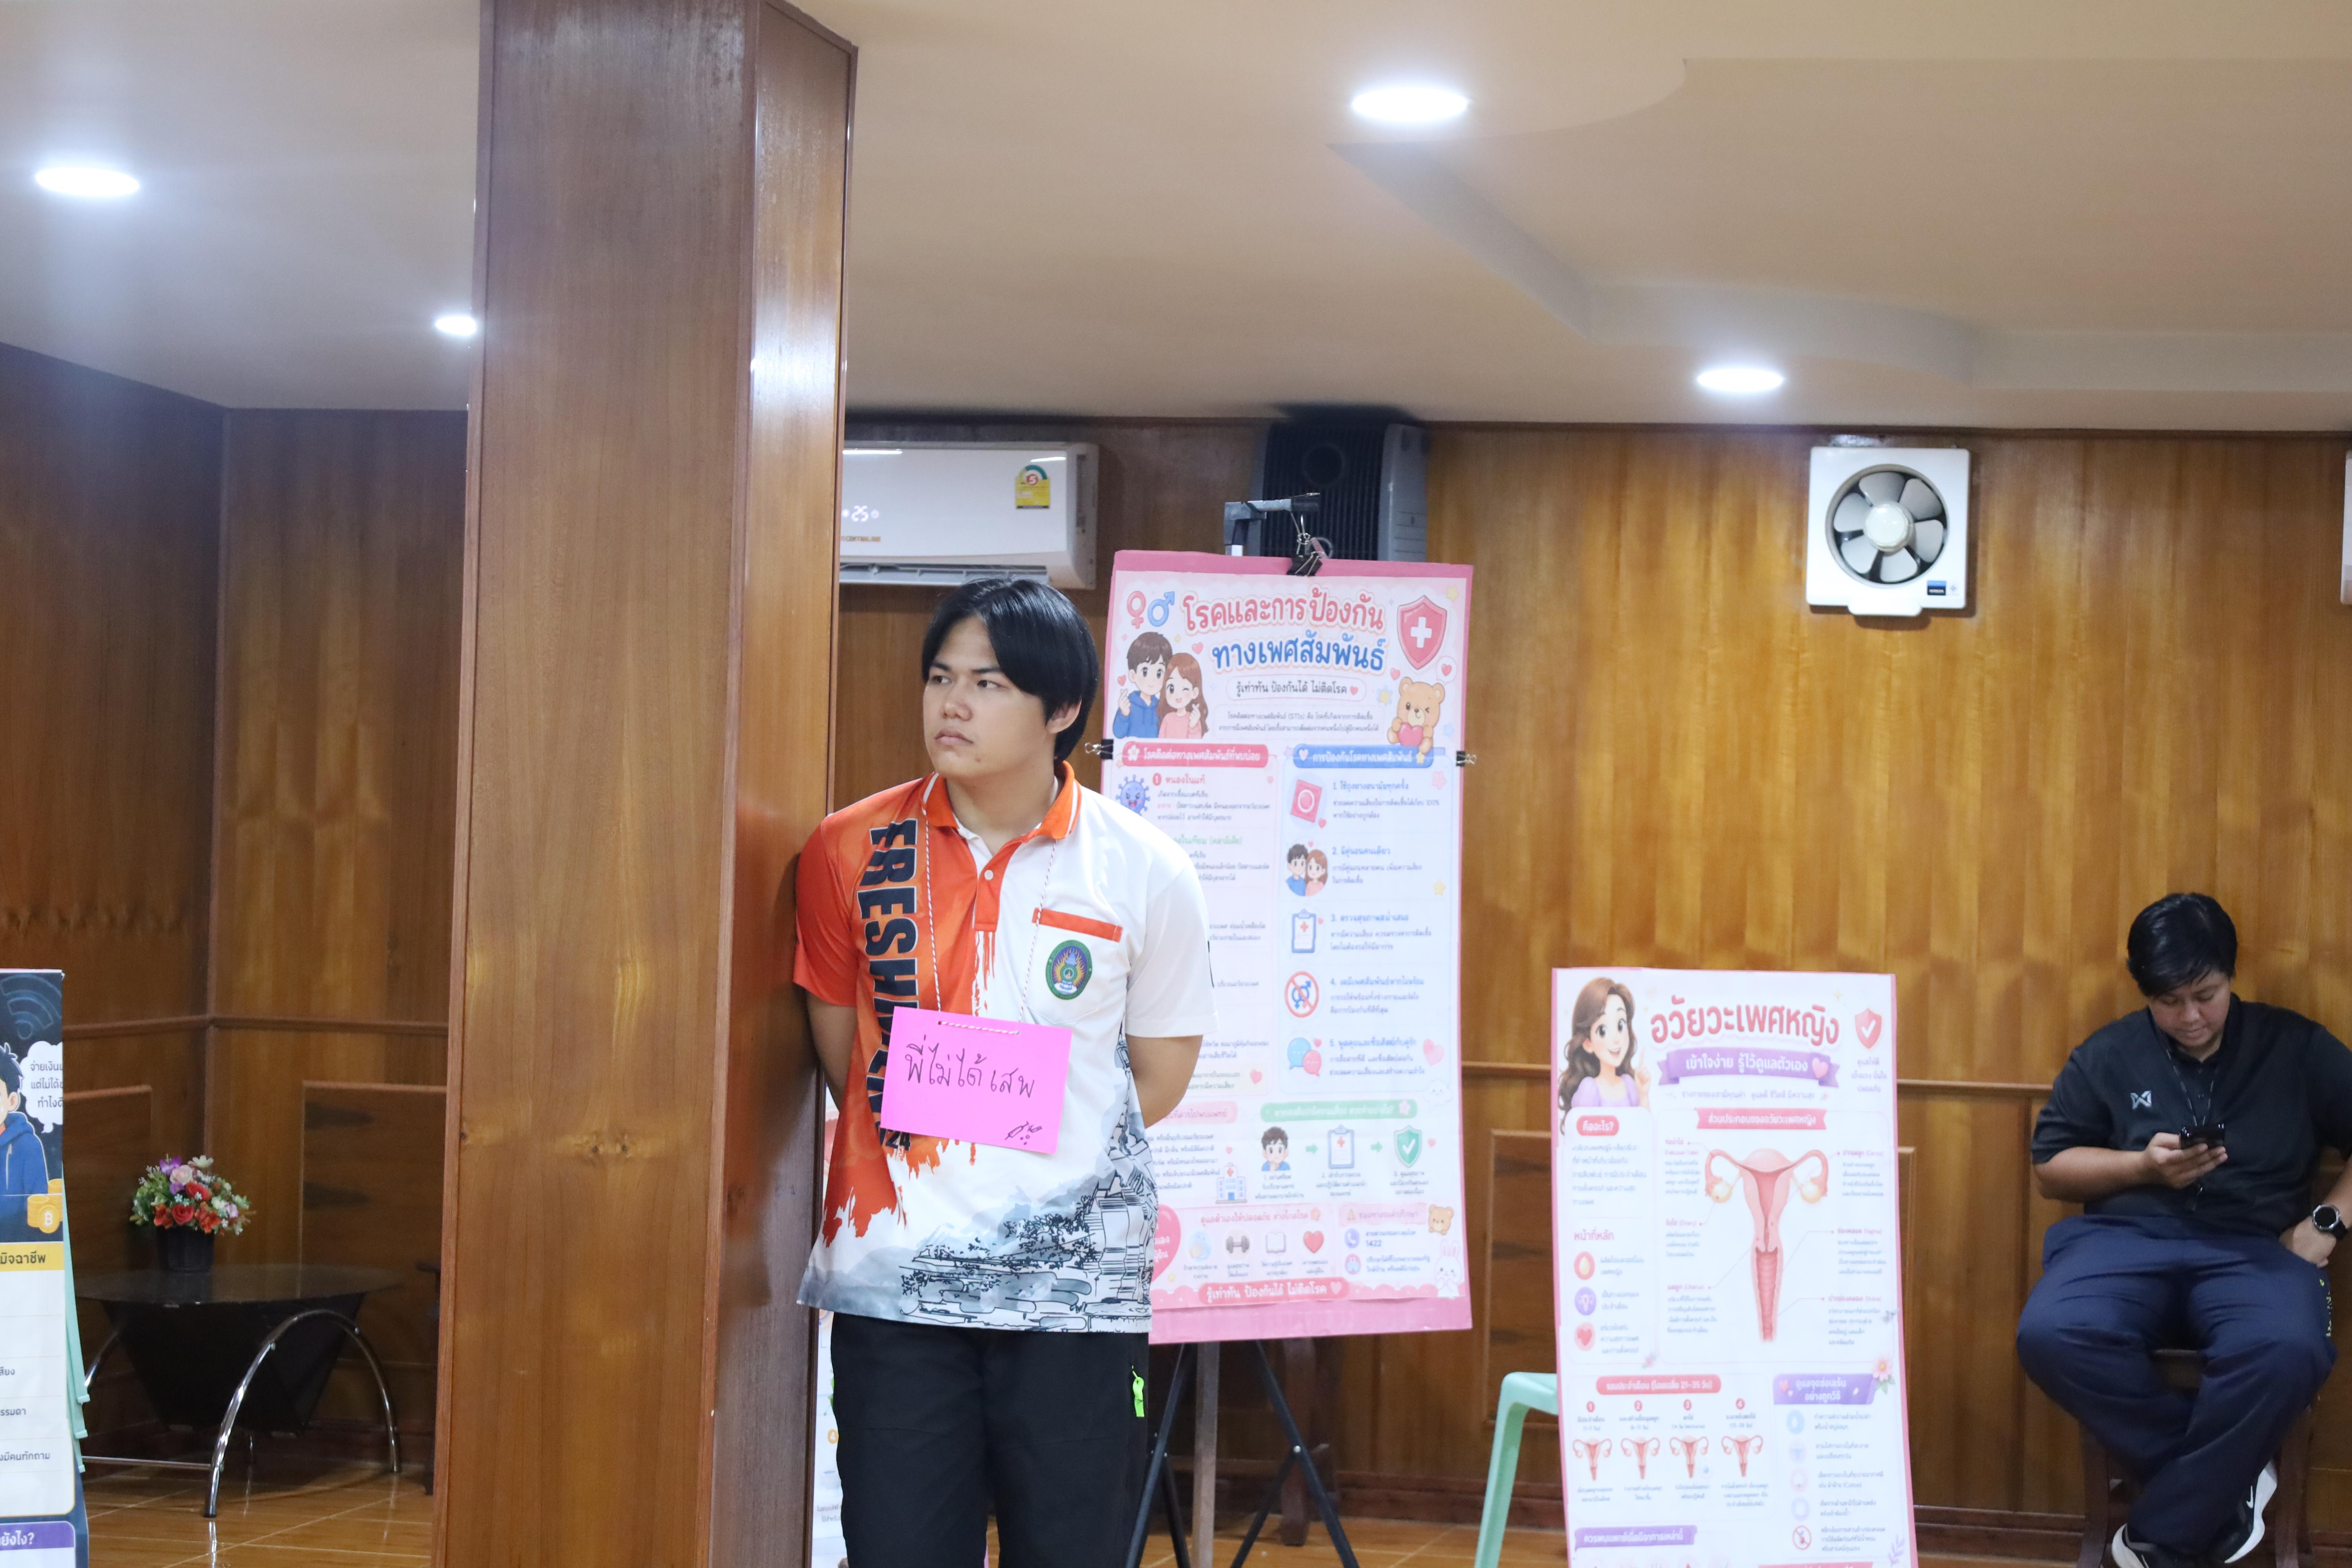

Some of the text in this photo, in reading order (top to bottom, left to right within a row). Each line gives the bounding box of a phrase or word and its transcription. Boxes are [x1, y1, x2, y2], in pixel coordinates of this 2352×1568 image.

[851, 505, 868, 522] 25
[1183, 587, 1383, 631] โรคและการป้องกัน
[1212, 629, 1386, 671] ทางเพศสัมพันธ์
[1236, 680, 1347, 697] รู้เท่าทัน ป้องกันได้ ไม่ติดโรค
[1312, 750, 1412, 763] การป้องกันโรคทางเพศสัมพันธ์
[1340, 778, 1409, 793] ใช้ถุงยางอนามัยทุกครั้ง
[1651, 995, 1839, 1046] อวัยวะเพศหญิง
[1686, 1053, 1808, 1073] เข้าใจง่าย รู้ไว้ดูแลตัวเอง
[1583, 1120, 1614, 1131] คืออะไร?
[1708, 1113, 1816, 1126] ส่วนประกอบของอวัยวะเพศหญิง
[1574, 1225, 1614, 1240] หน้าที่หลัก
[0, 1250, 46, 1264] มิจฉาชีพ
[1207, 1280, 1327, 1303] รู้เท่าทัน ป้องกันได้ ไม่ติดโรค
[1796, 1377, 1846, 1390] ดูแลจุดซ่อนเร้น
[1805, 1390, 1841, 1403] อย่างถูกวิธี
[830, 1432, 836, 1440] 4
[1584, 1528, 1683, 1543] ควรพบแพทย์เมื่อมีอาการเหล่านี้
